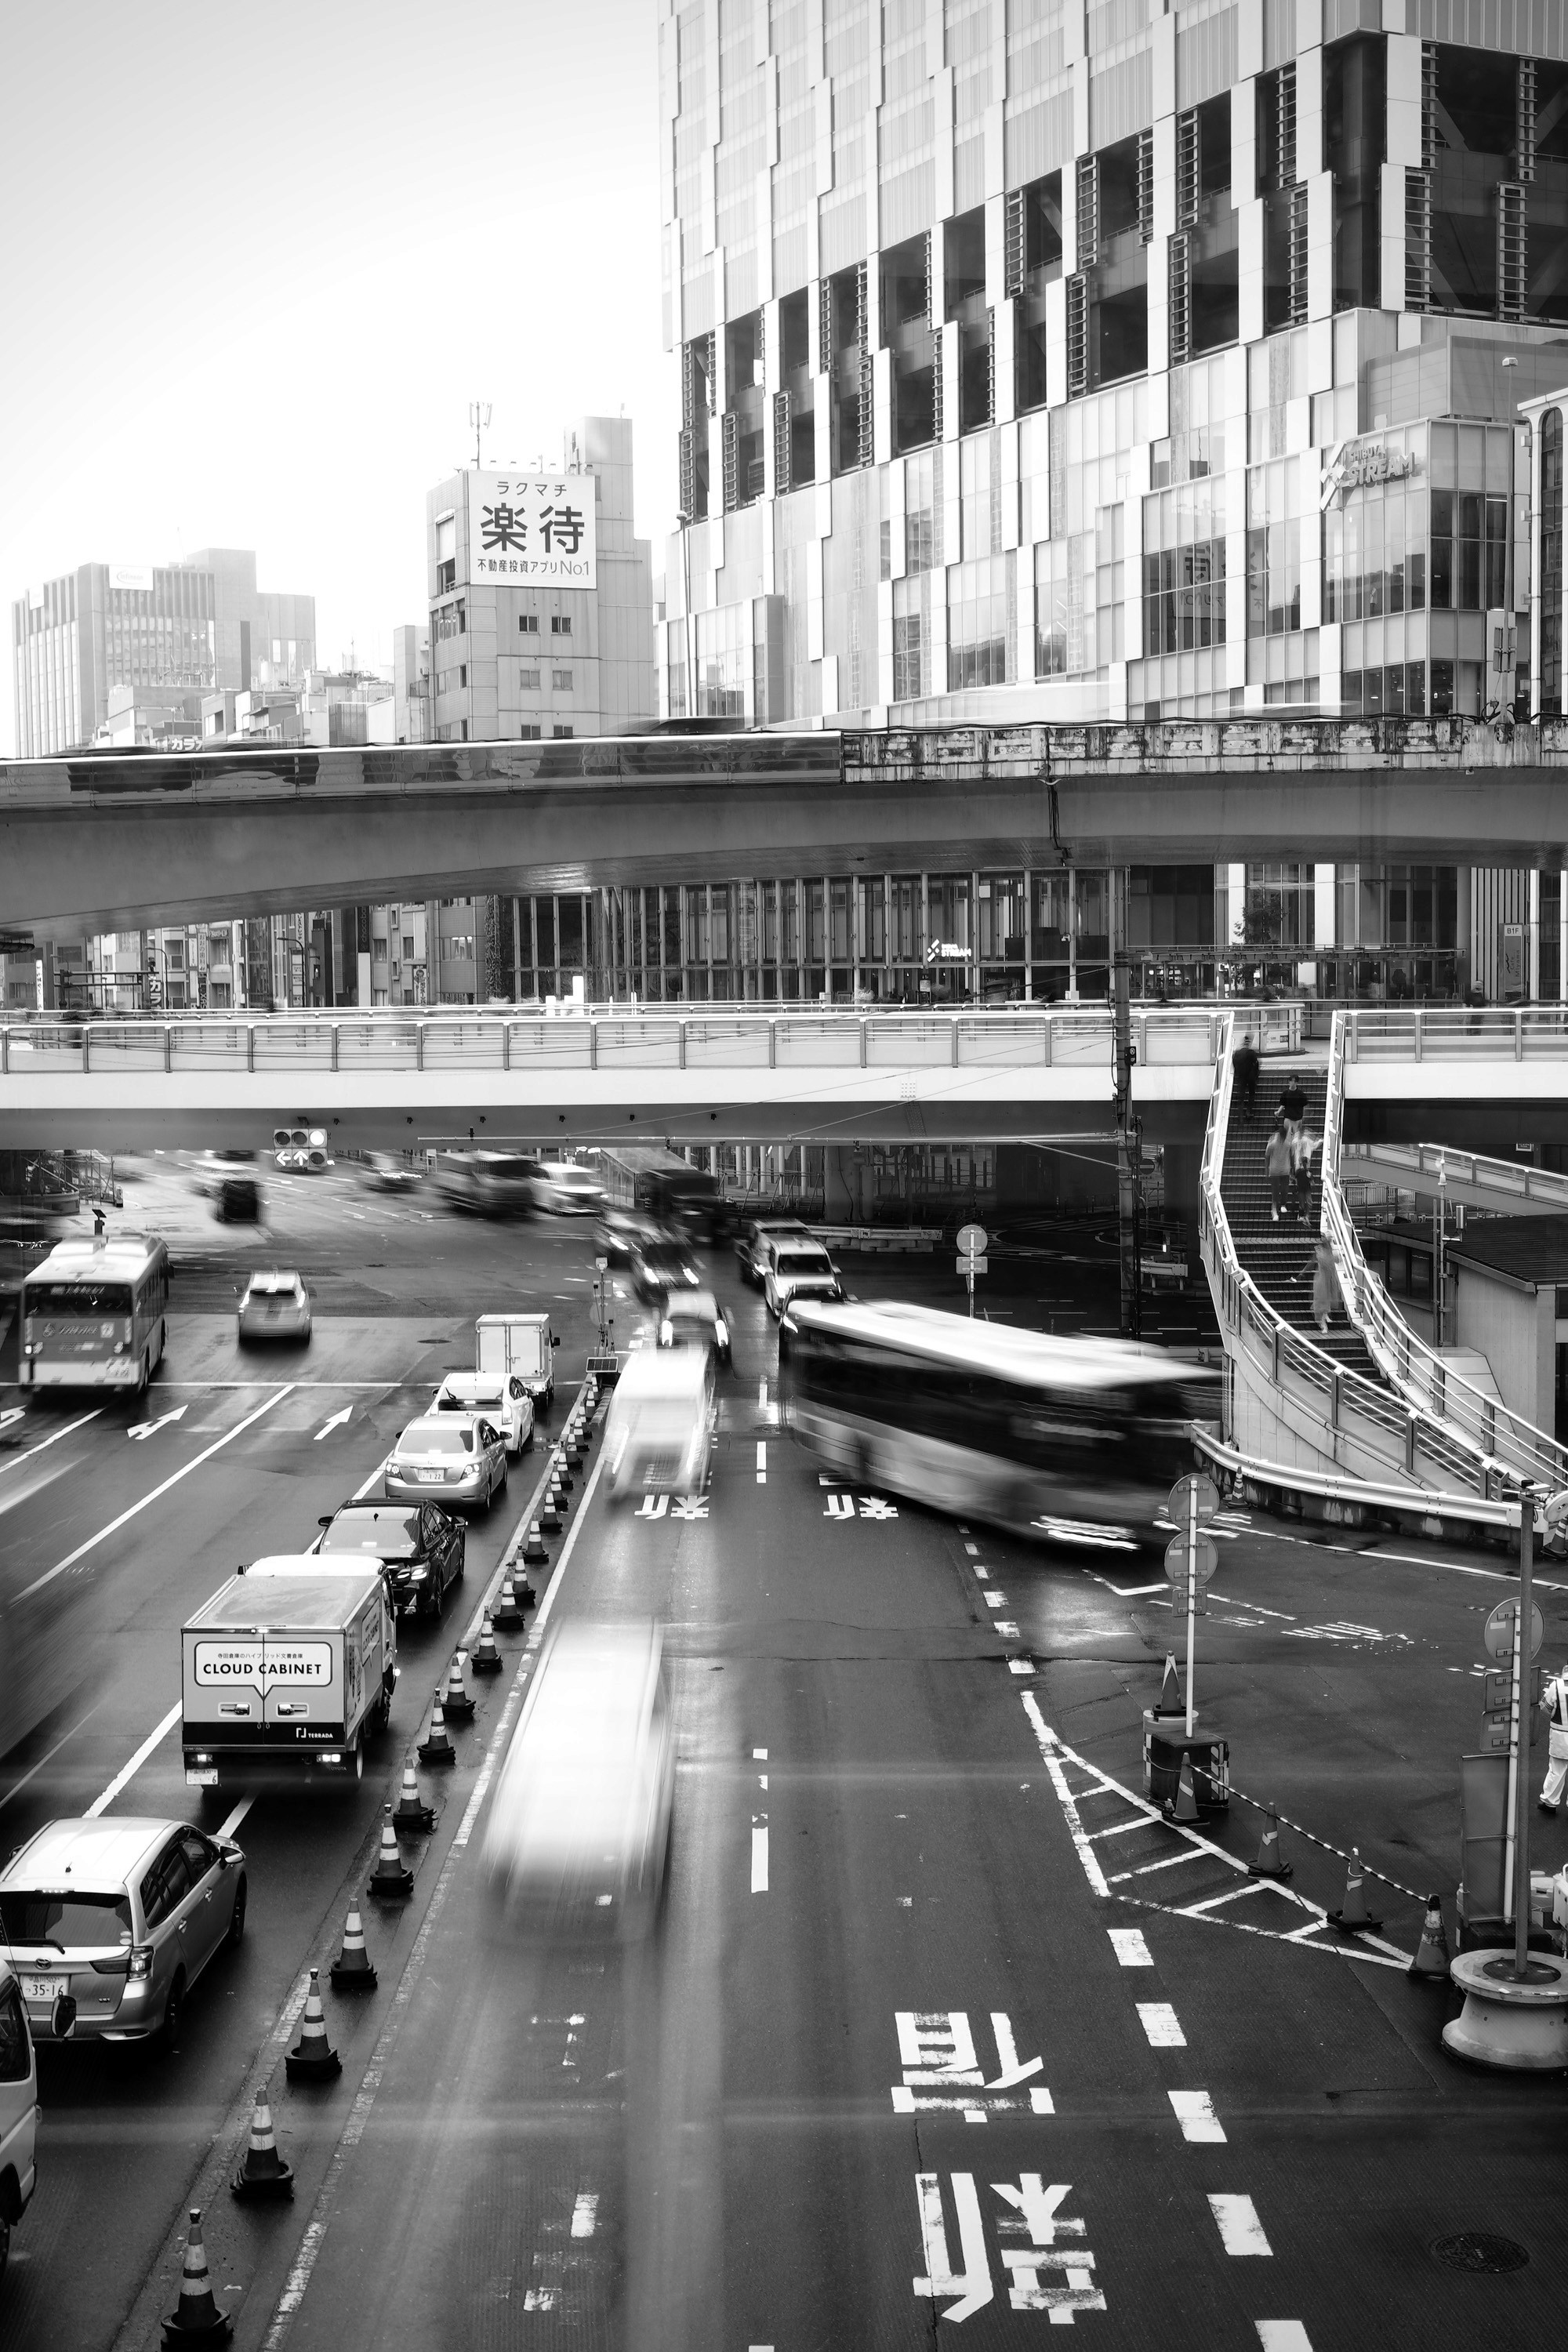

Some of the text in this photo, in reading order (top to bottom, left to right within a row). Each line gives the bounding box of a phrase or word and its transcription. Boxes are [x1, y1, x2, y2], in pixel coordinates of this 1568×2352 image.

[1351, 445, 1385, 462] SHIBUYA
[1348, 452, 1414, 487] STREAM
[497, 481, 567, 497] ラクマチ
[480, 502, 585, 554] 楽待
[203, 1663, 322, 1675] CLOUD CABINET
[212, 1775, 216, 1784] 6
[32, 1984, 64, 1996] 35-16
[891, 2012, 1108, 2325] 新宿
